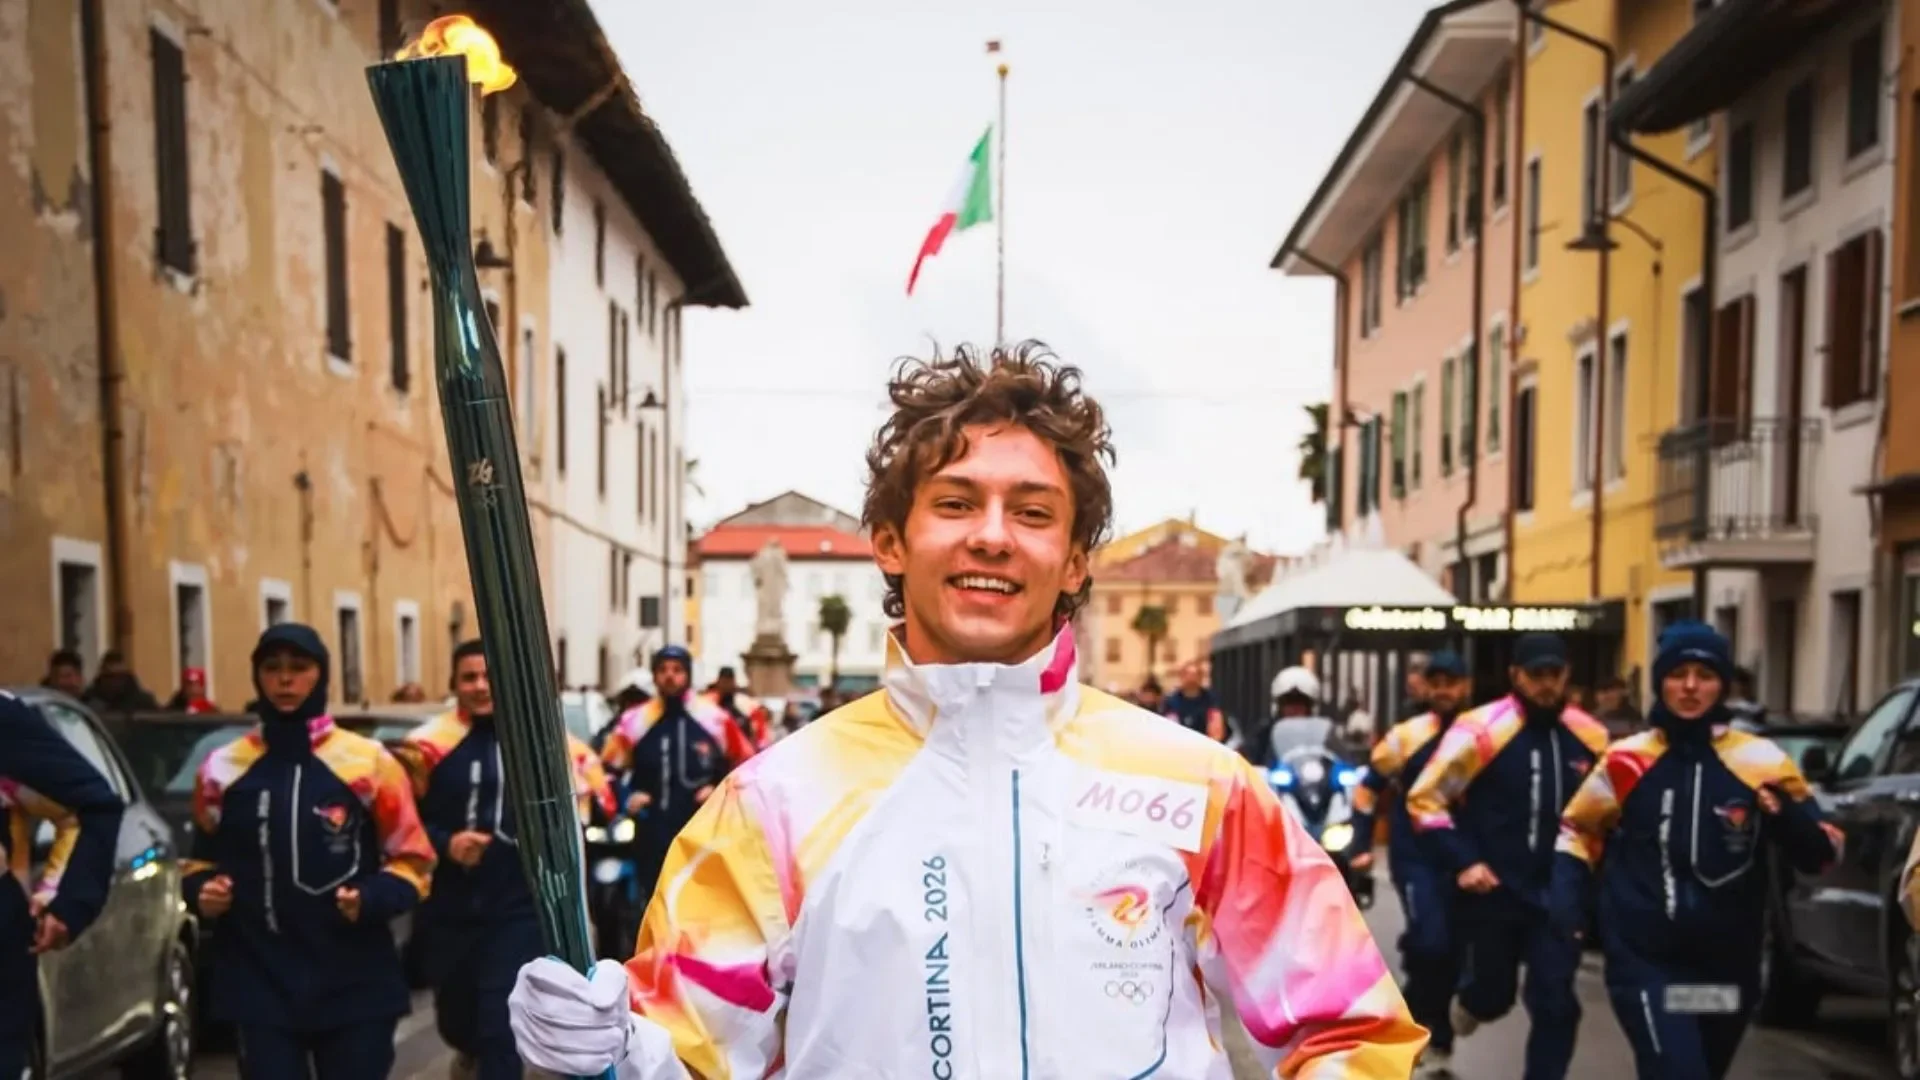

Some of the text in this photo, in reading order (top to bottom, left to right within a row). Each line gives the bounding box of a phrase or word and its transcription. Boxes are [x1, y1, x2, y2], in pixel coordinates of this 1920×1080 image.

[1076, 781, 1195, 830] M066
[922, 856, 952, 1080] CORTINA 2026
